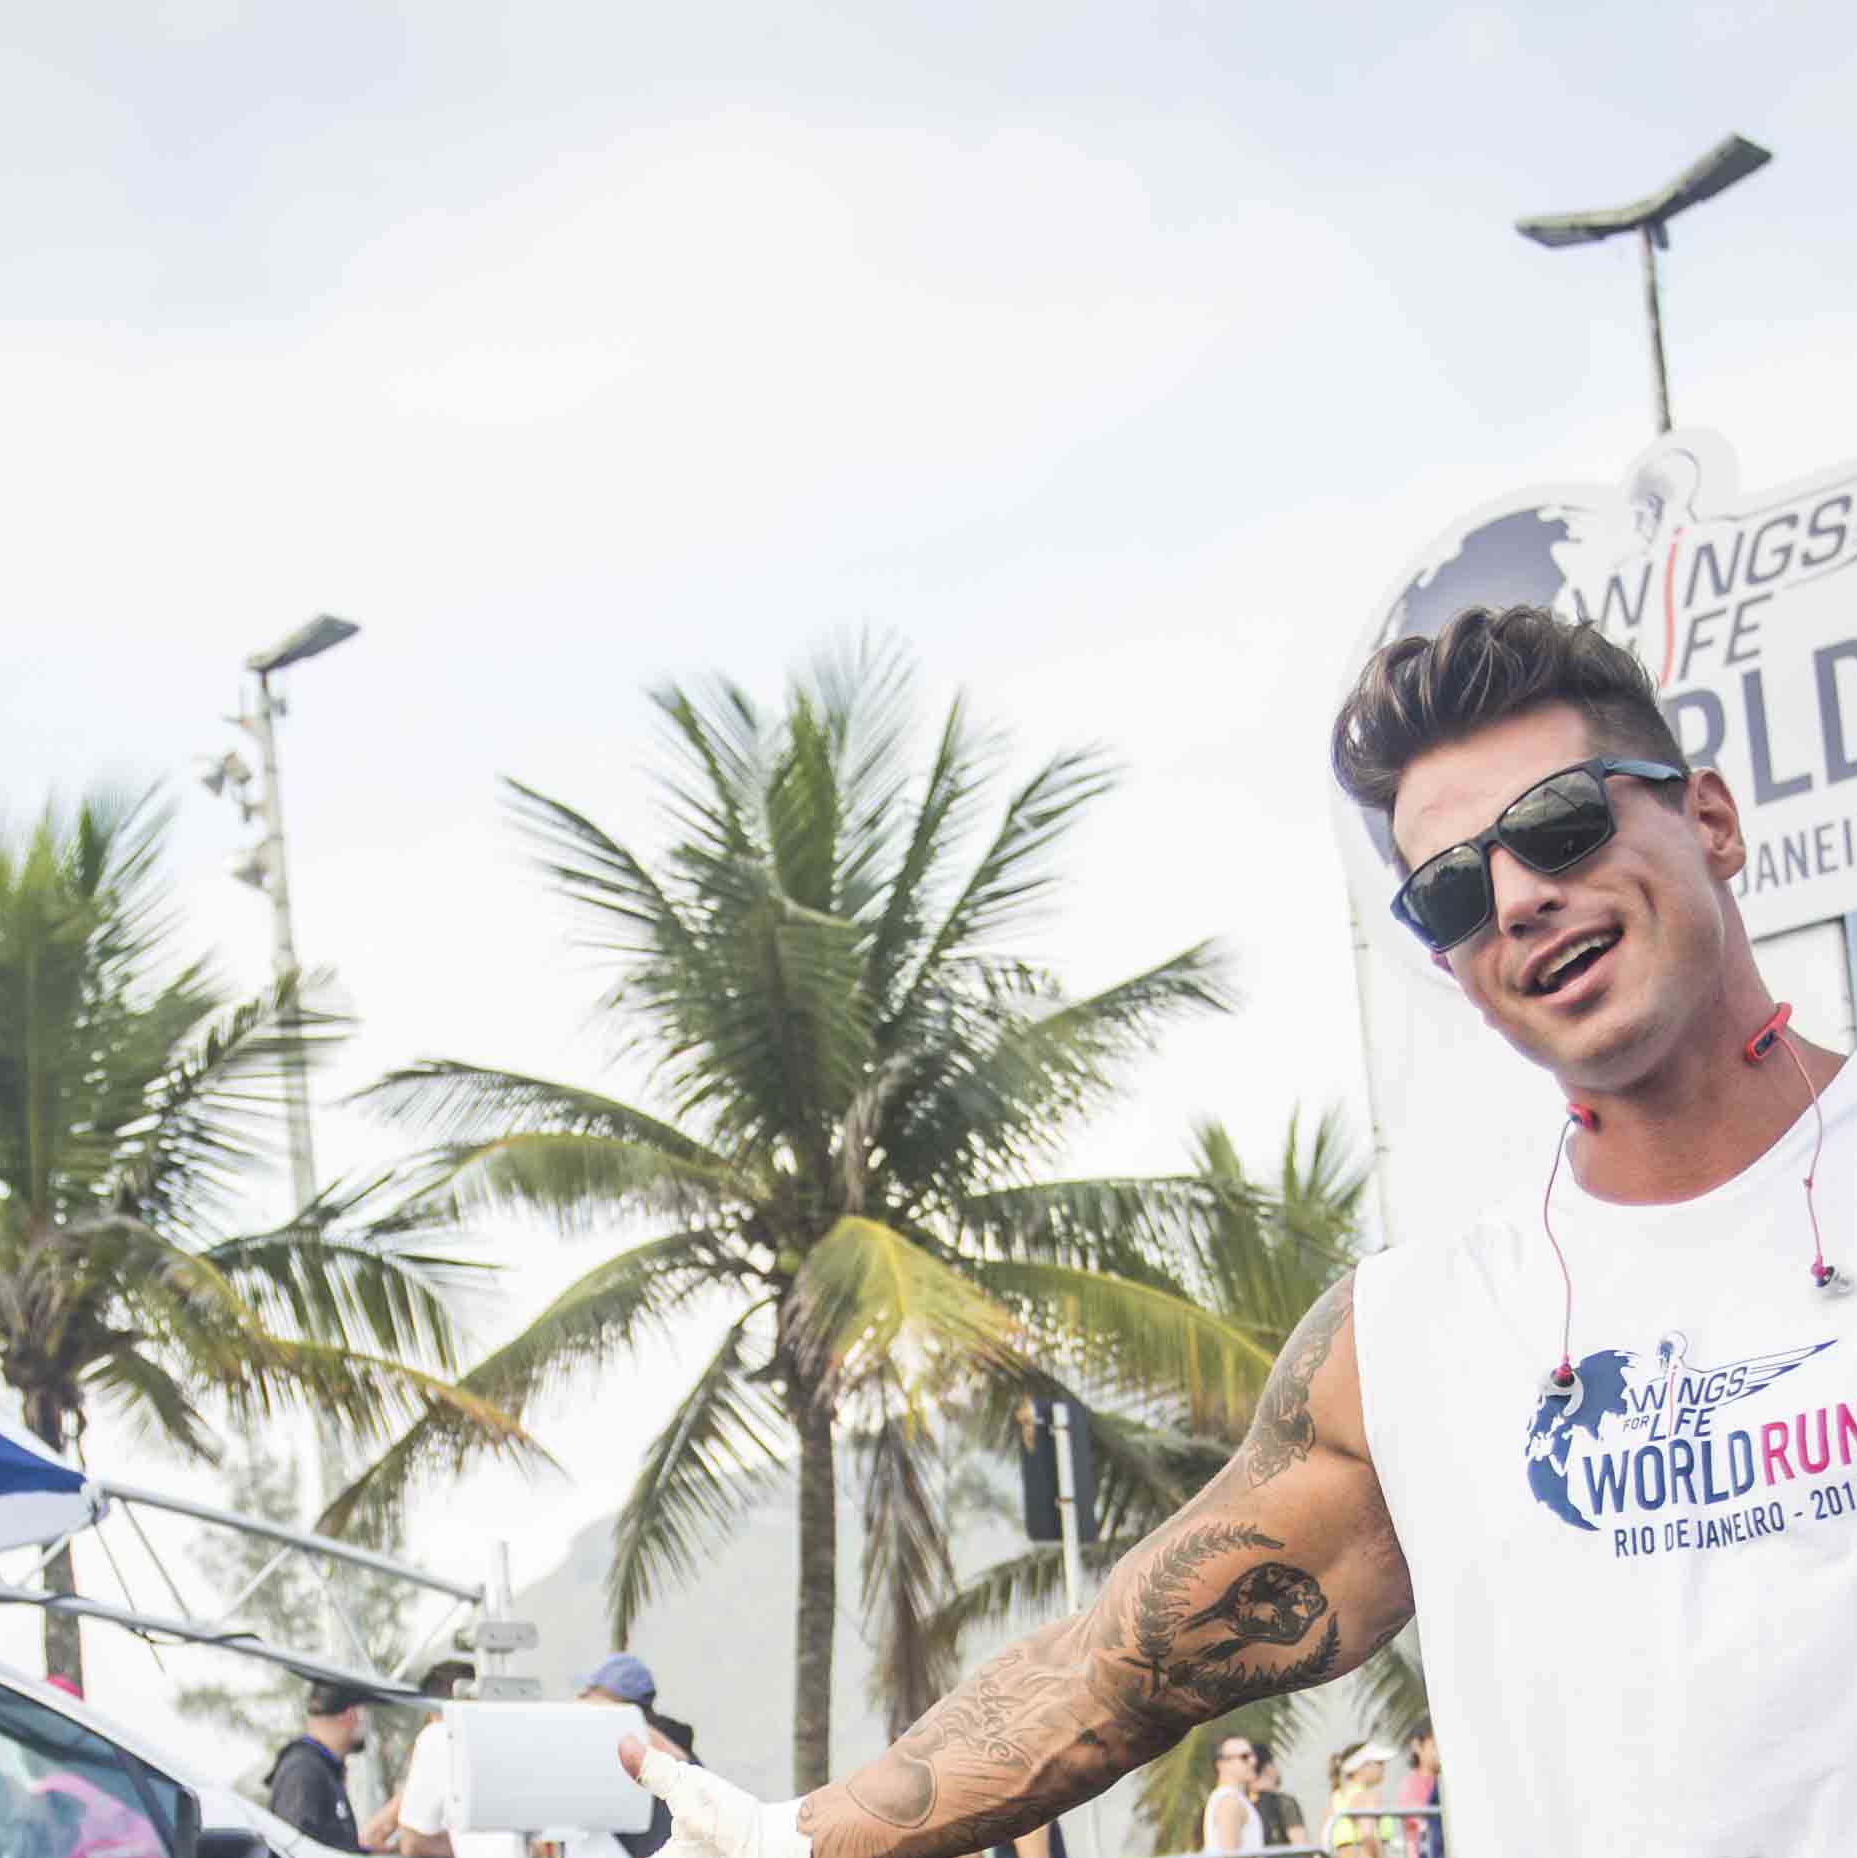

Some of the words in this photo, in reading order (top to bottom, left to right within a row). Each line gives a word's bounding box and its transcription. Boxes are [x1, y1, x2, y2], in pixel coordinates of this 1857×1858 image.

[1622, 1415, 1650, 1432] FOR
[1614, 1526, 1655, 1558] RIO
[1665, 1523, 1689, 1552] DE
[1696, 1502, 1785, 1550] JANEIRO
